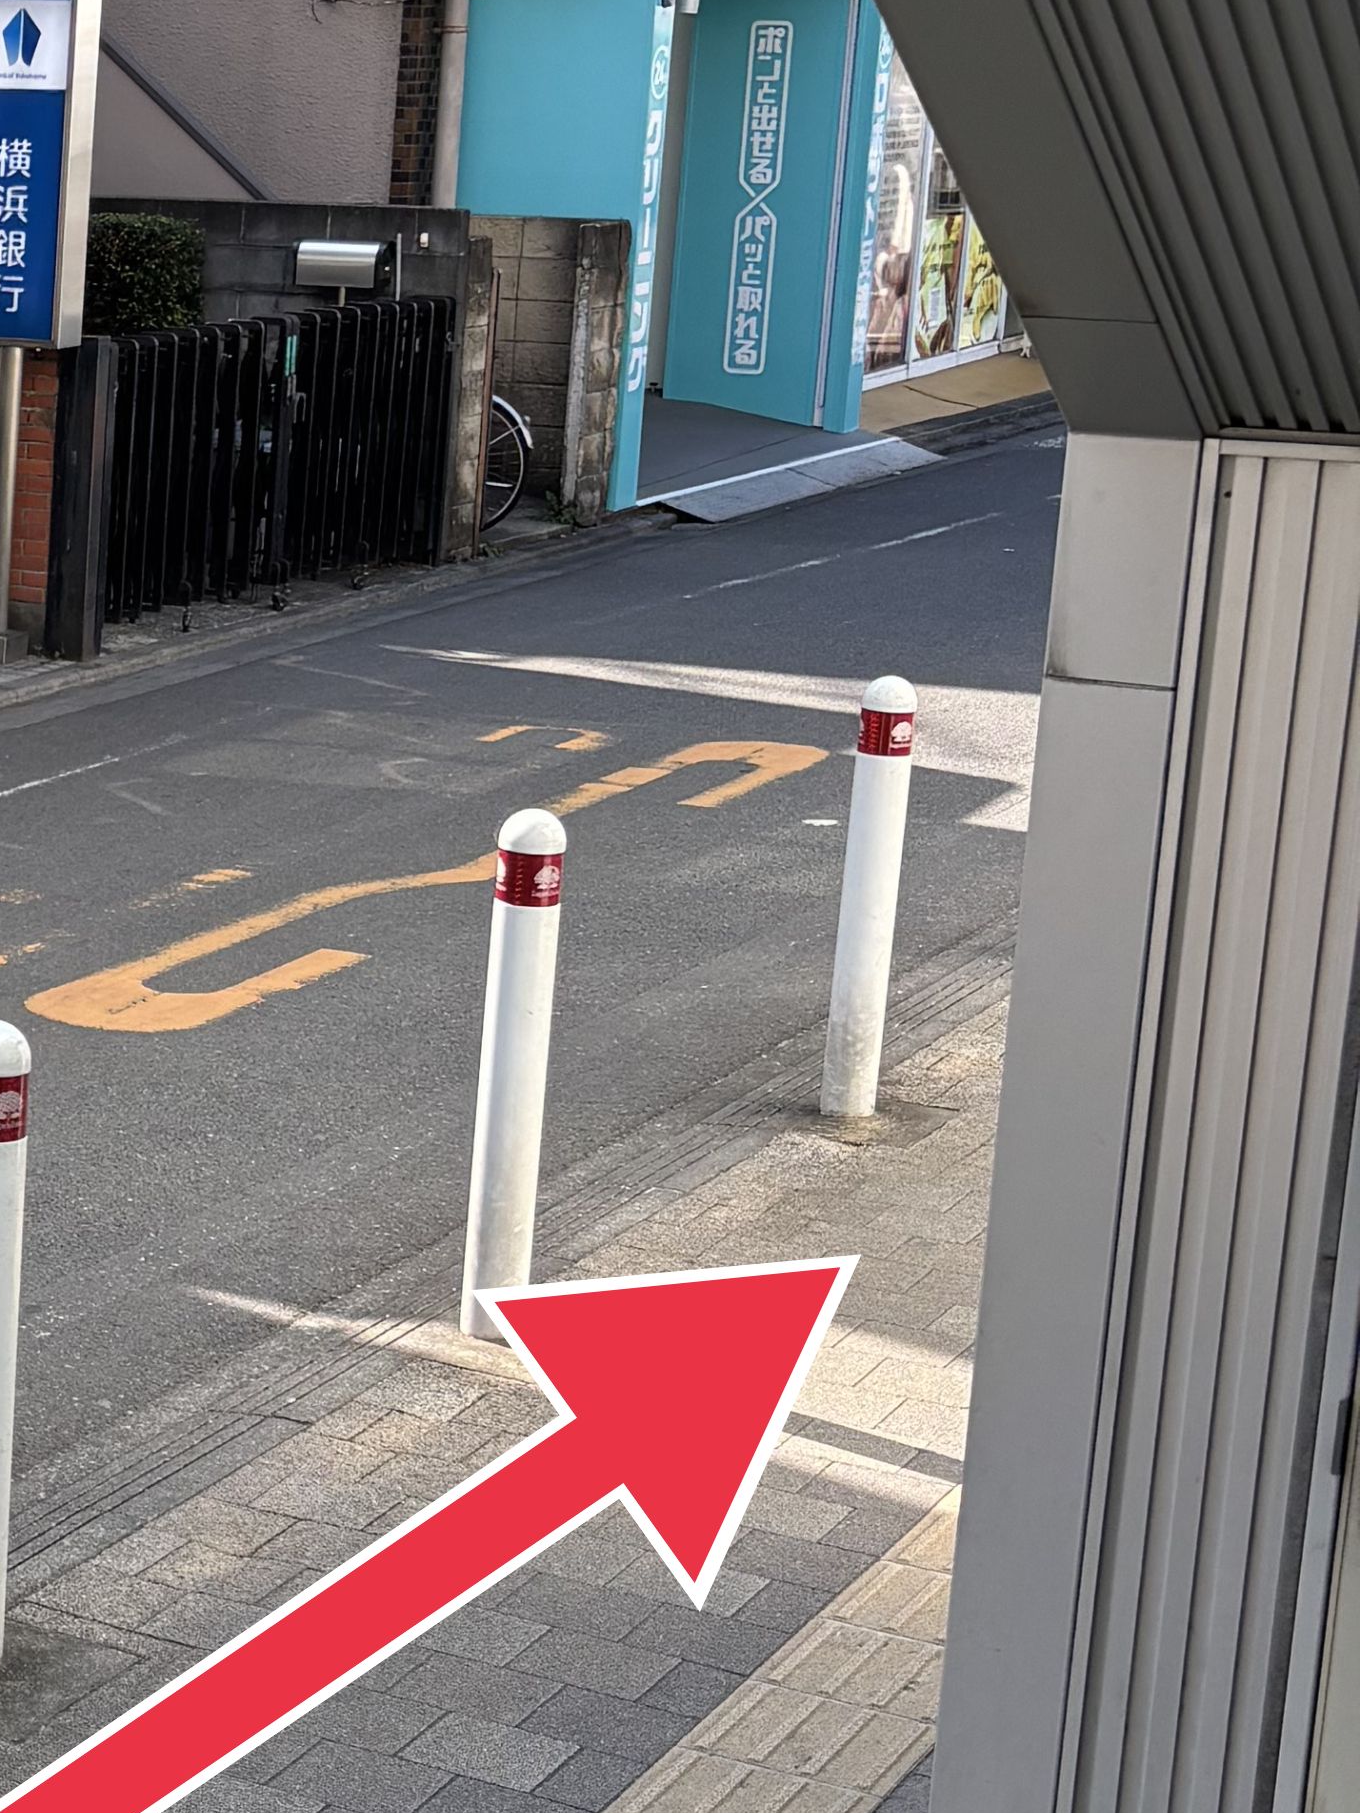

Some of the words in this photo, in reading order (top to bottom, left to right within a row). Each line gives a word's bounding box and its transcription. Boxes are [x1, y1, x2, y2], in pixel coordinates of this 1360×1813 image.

[749, 26, 786, 185] ポンと出せる
[733, 215, 771, 366] パッと取れる
